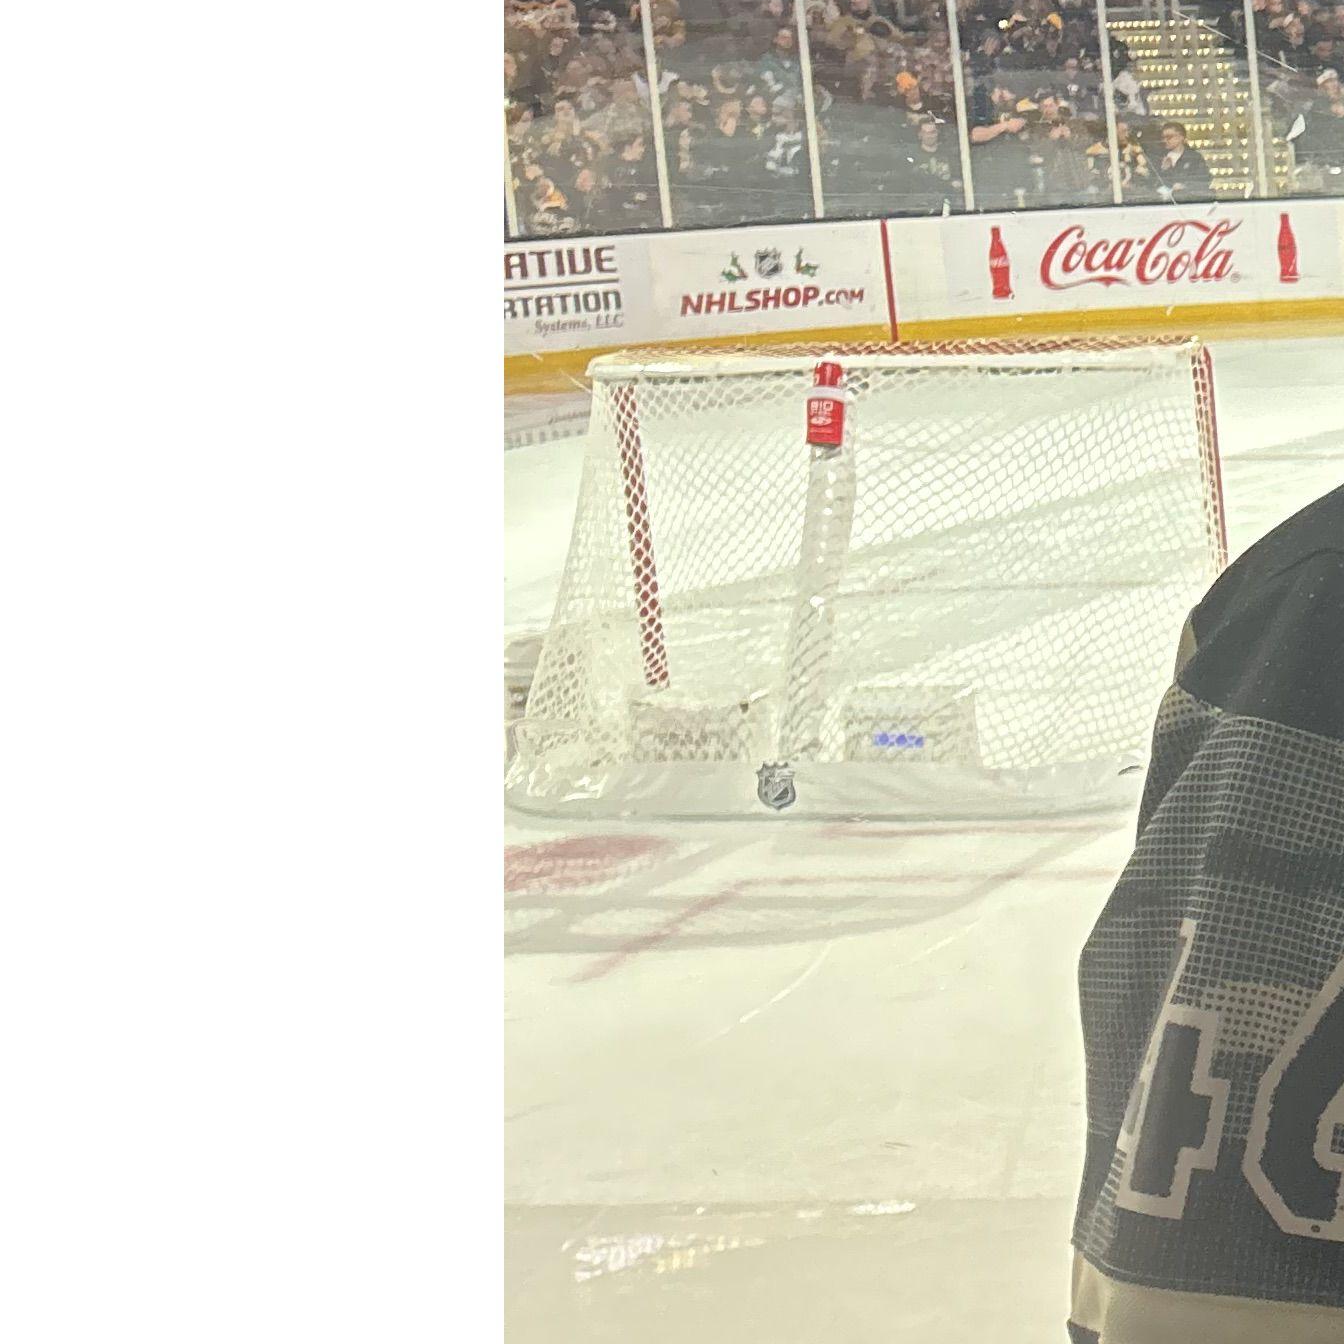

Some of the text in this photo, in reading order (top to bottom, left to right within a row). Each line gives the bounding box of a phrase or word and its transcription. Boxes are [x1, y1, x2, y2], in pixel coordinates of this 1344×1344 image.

[1040, 218, 1244, 290] Coca-Cola
[534, 313, 625, 338] Systems, LLC
